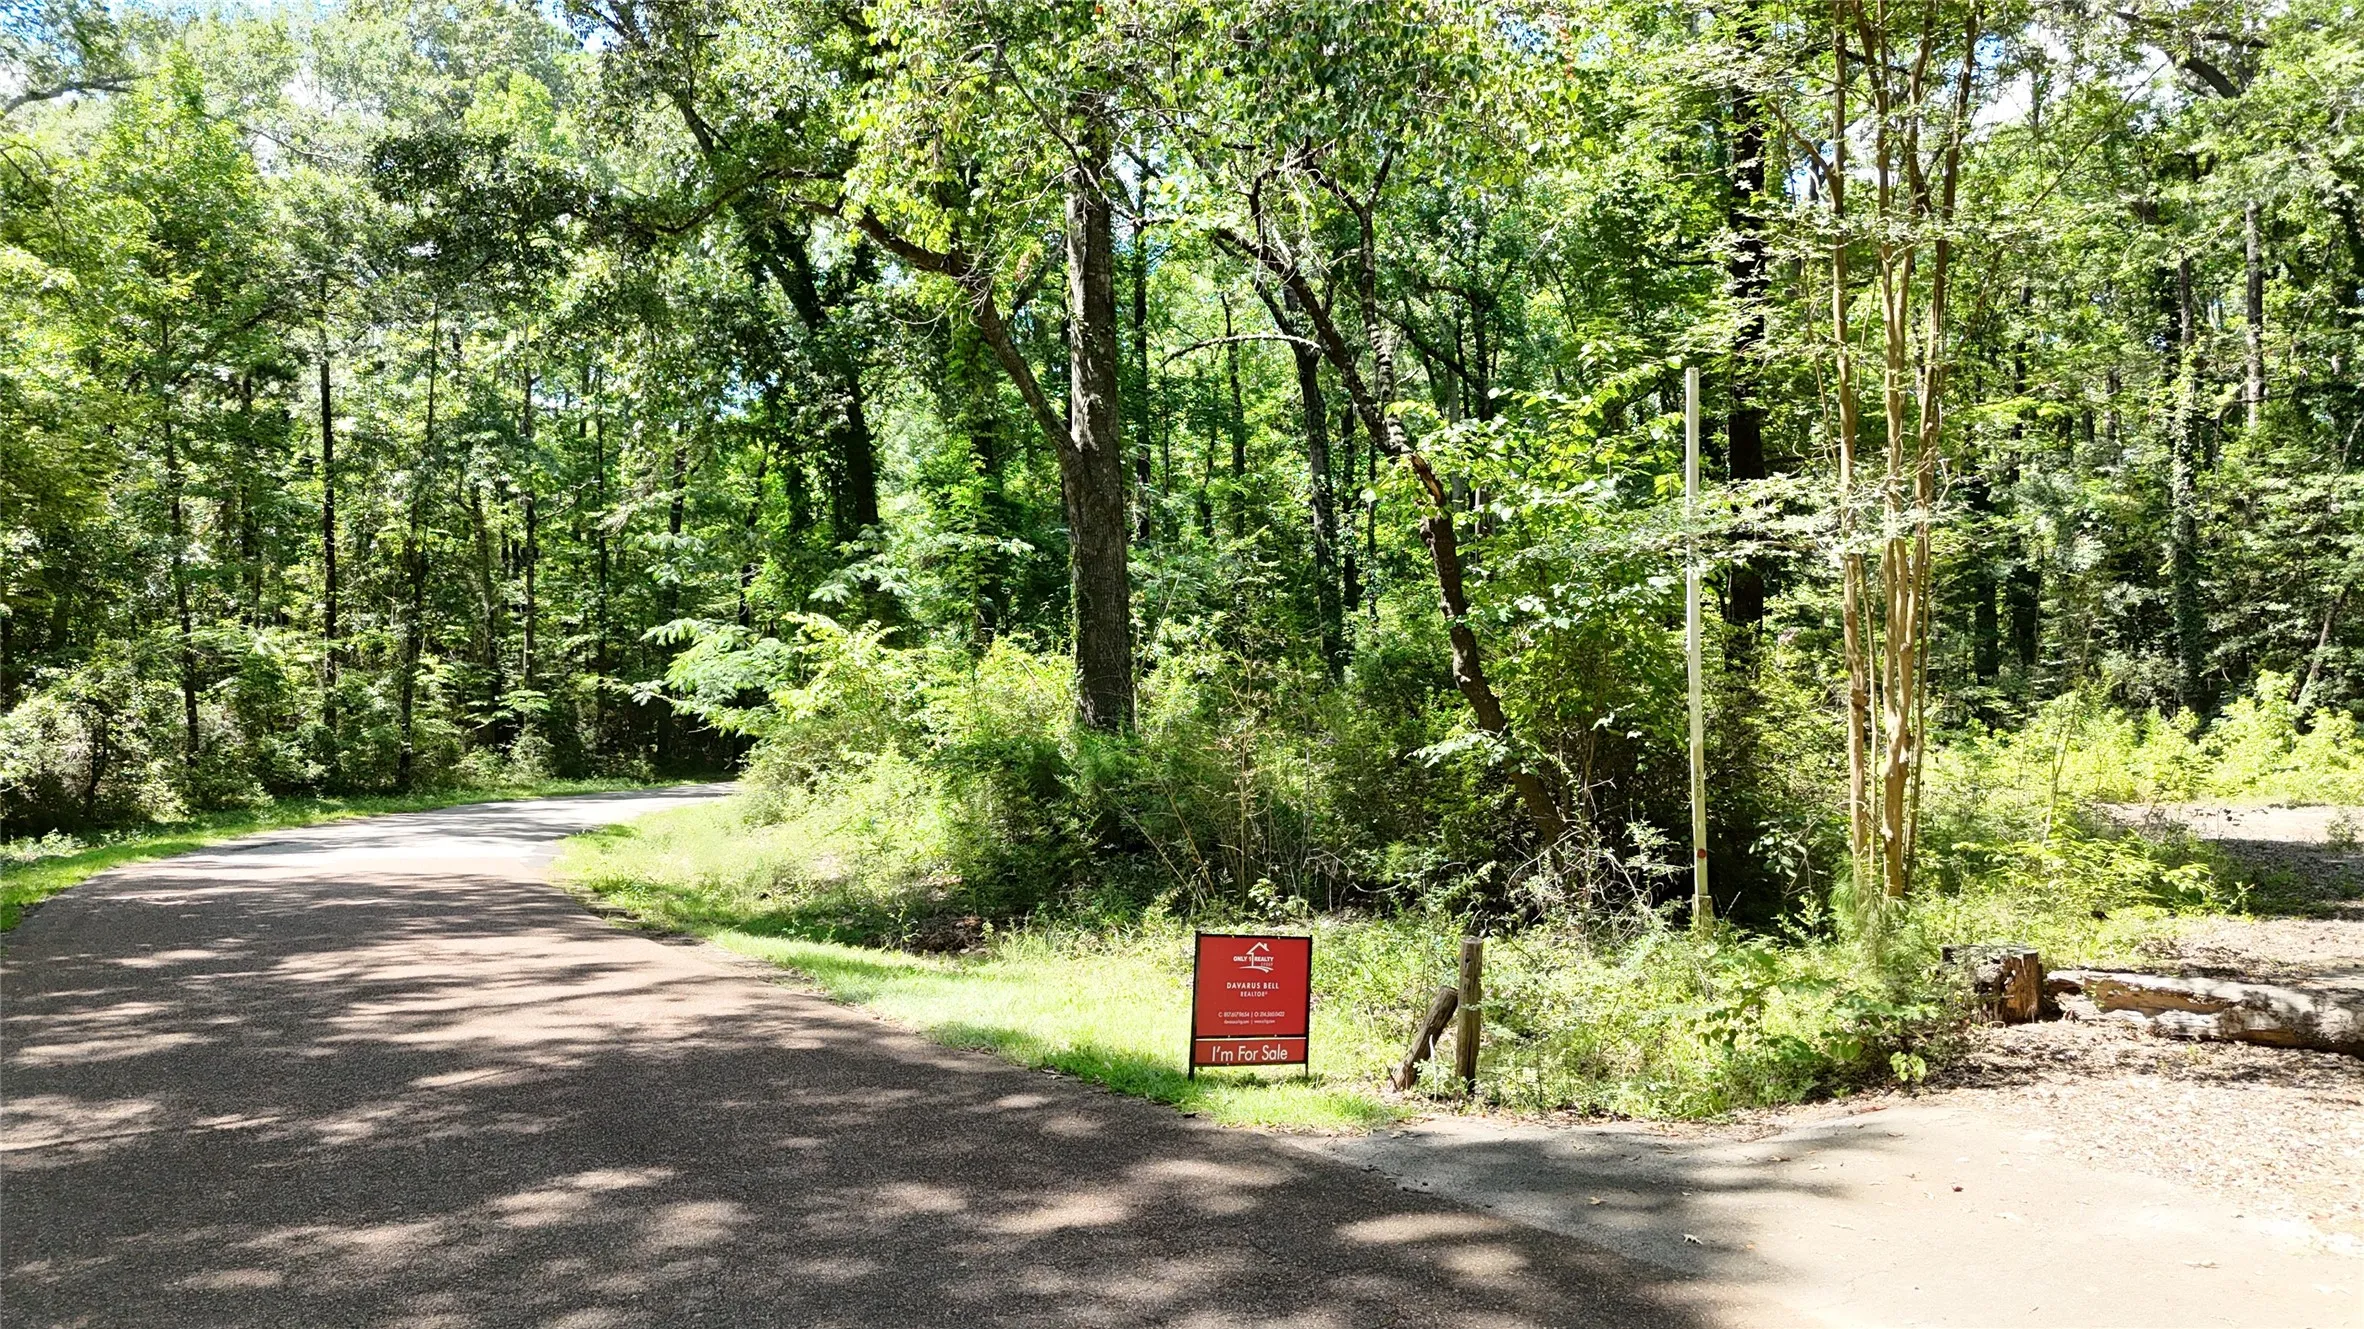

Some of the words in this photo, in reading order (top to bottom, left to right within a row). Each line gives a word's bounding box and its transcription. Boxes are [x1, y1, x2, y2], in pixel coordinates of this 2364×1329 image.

[1212, 1046, 1233, 1062] I'm
[1238, 1046, 1259, 1061] For
[1261, 1044, 1288, 1060] Sale
